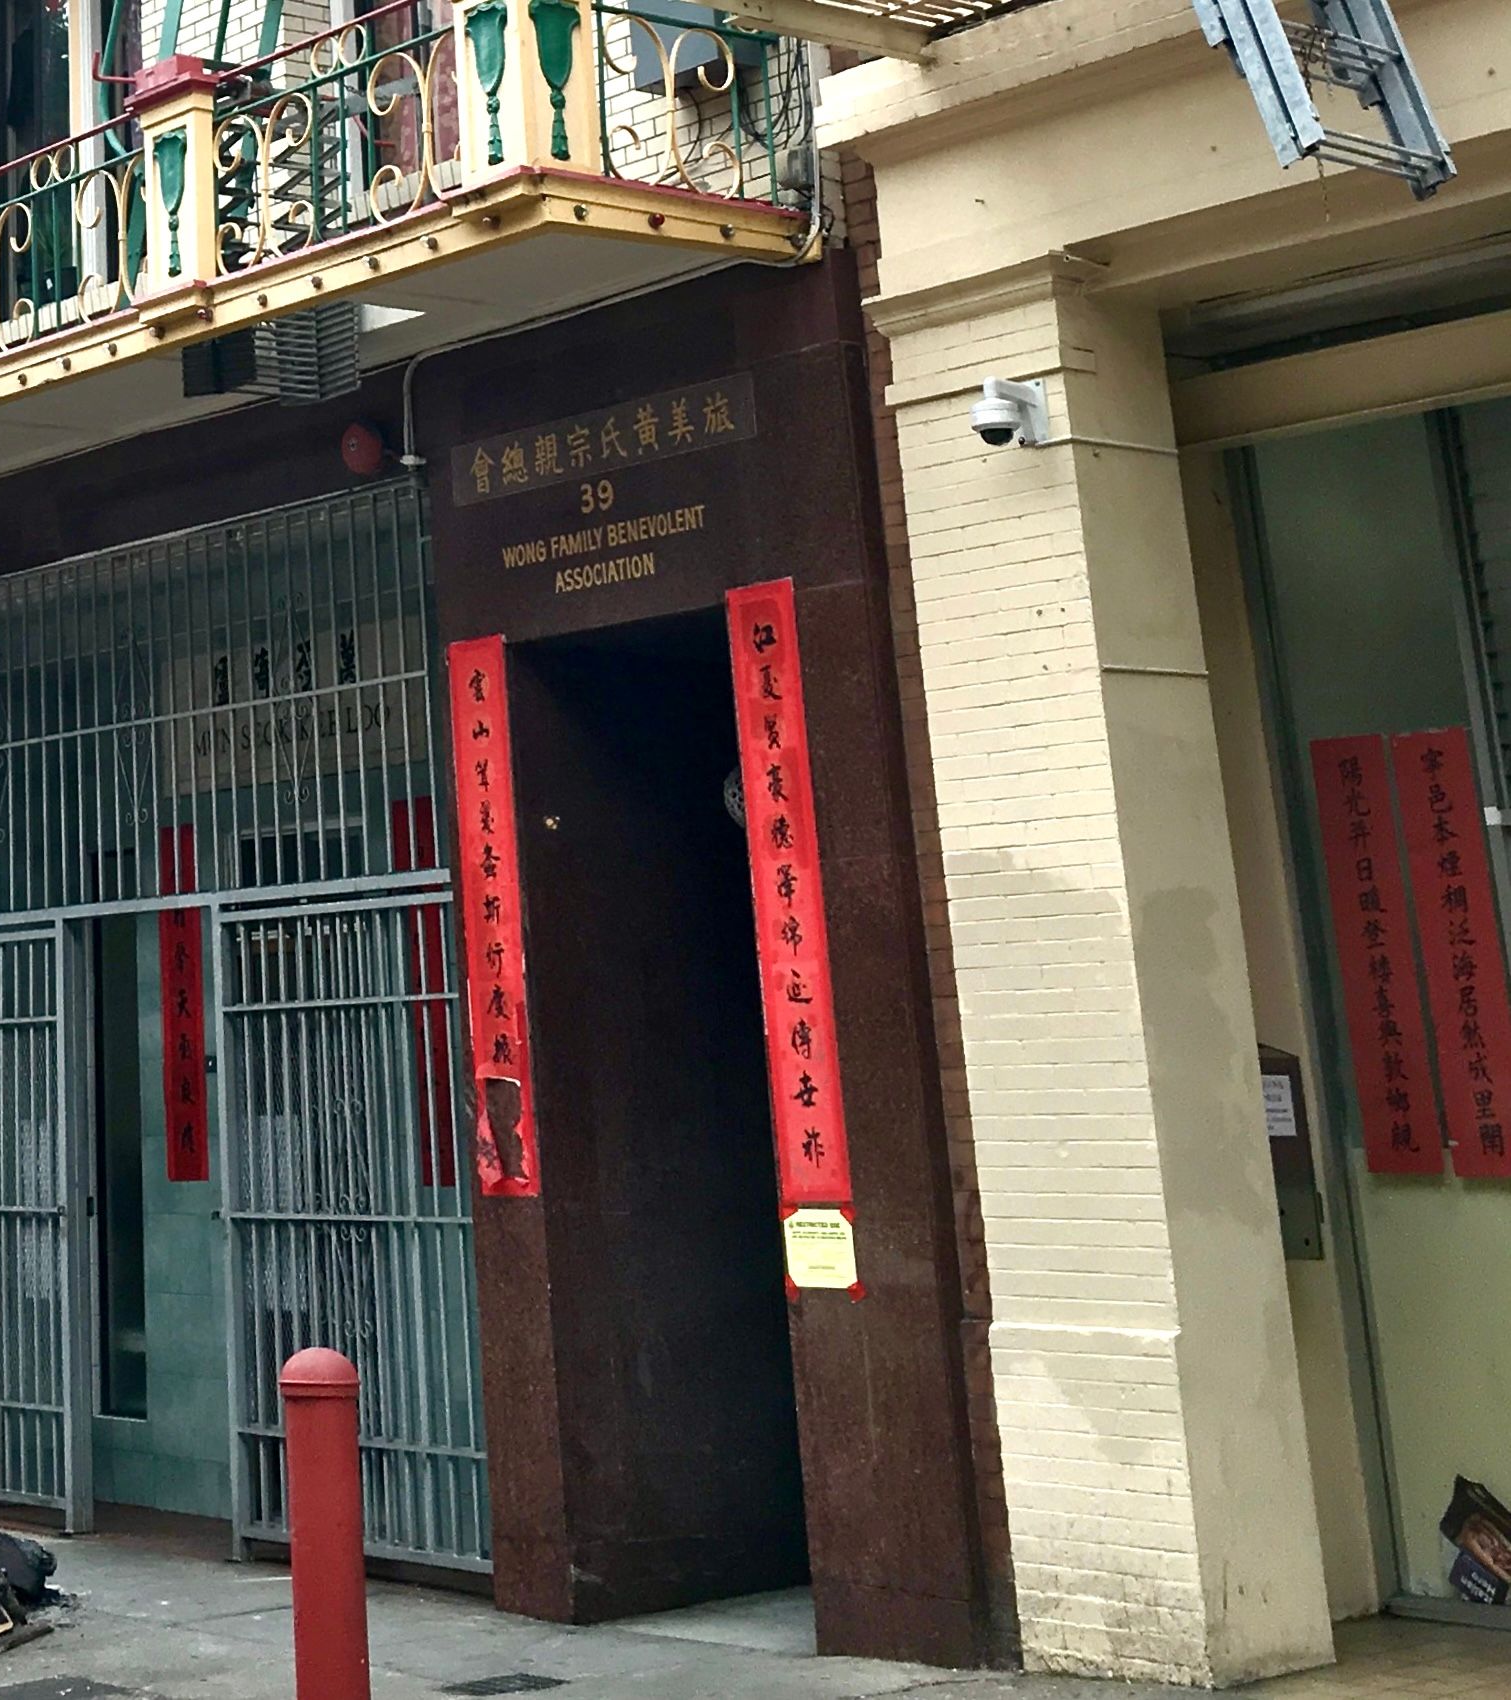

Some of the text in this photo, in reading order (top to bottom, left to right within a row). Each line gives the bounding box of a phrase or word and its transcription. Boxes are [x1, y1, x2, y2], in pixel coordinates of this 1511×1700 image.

[580, 480, 615, 514] 39
[502, 505, 705, 569] WONG FAMILY BENEVOLENT
[555, 552, 656, 594] ASSOCIATION
